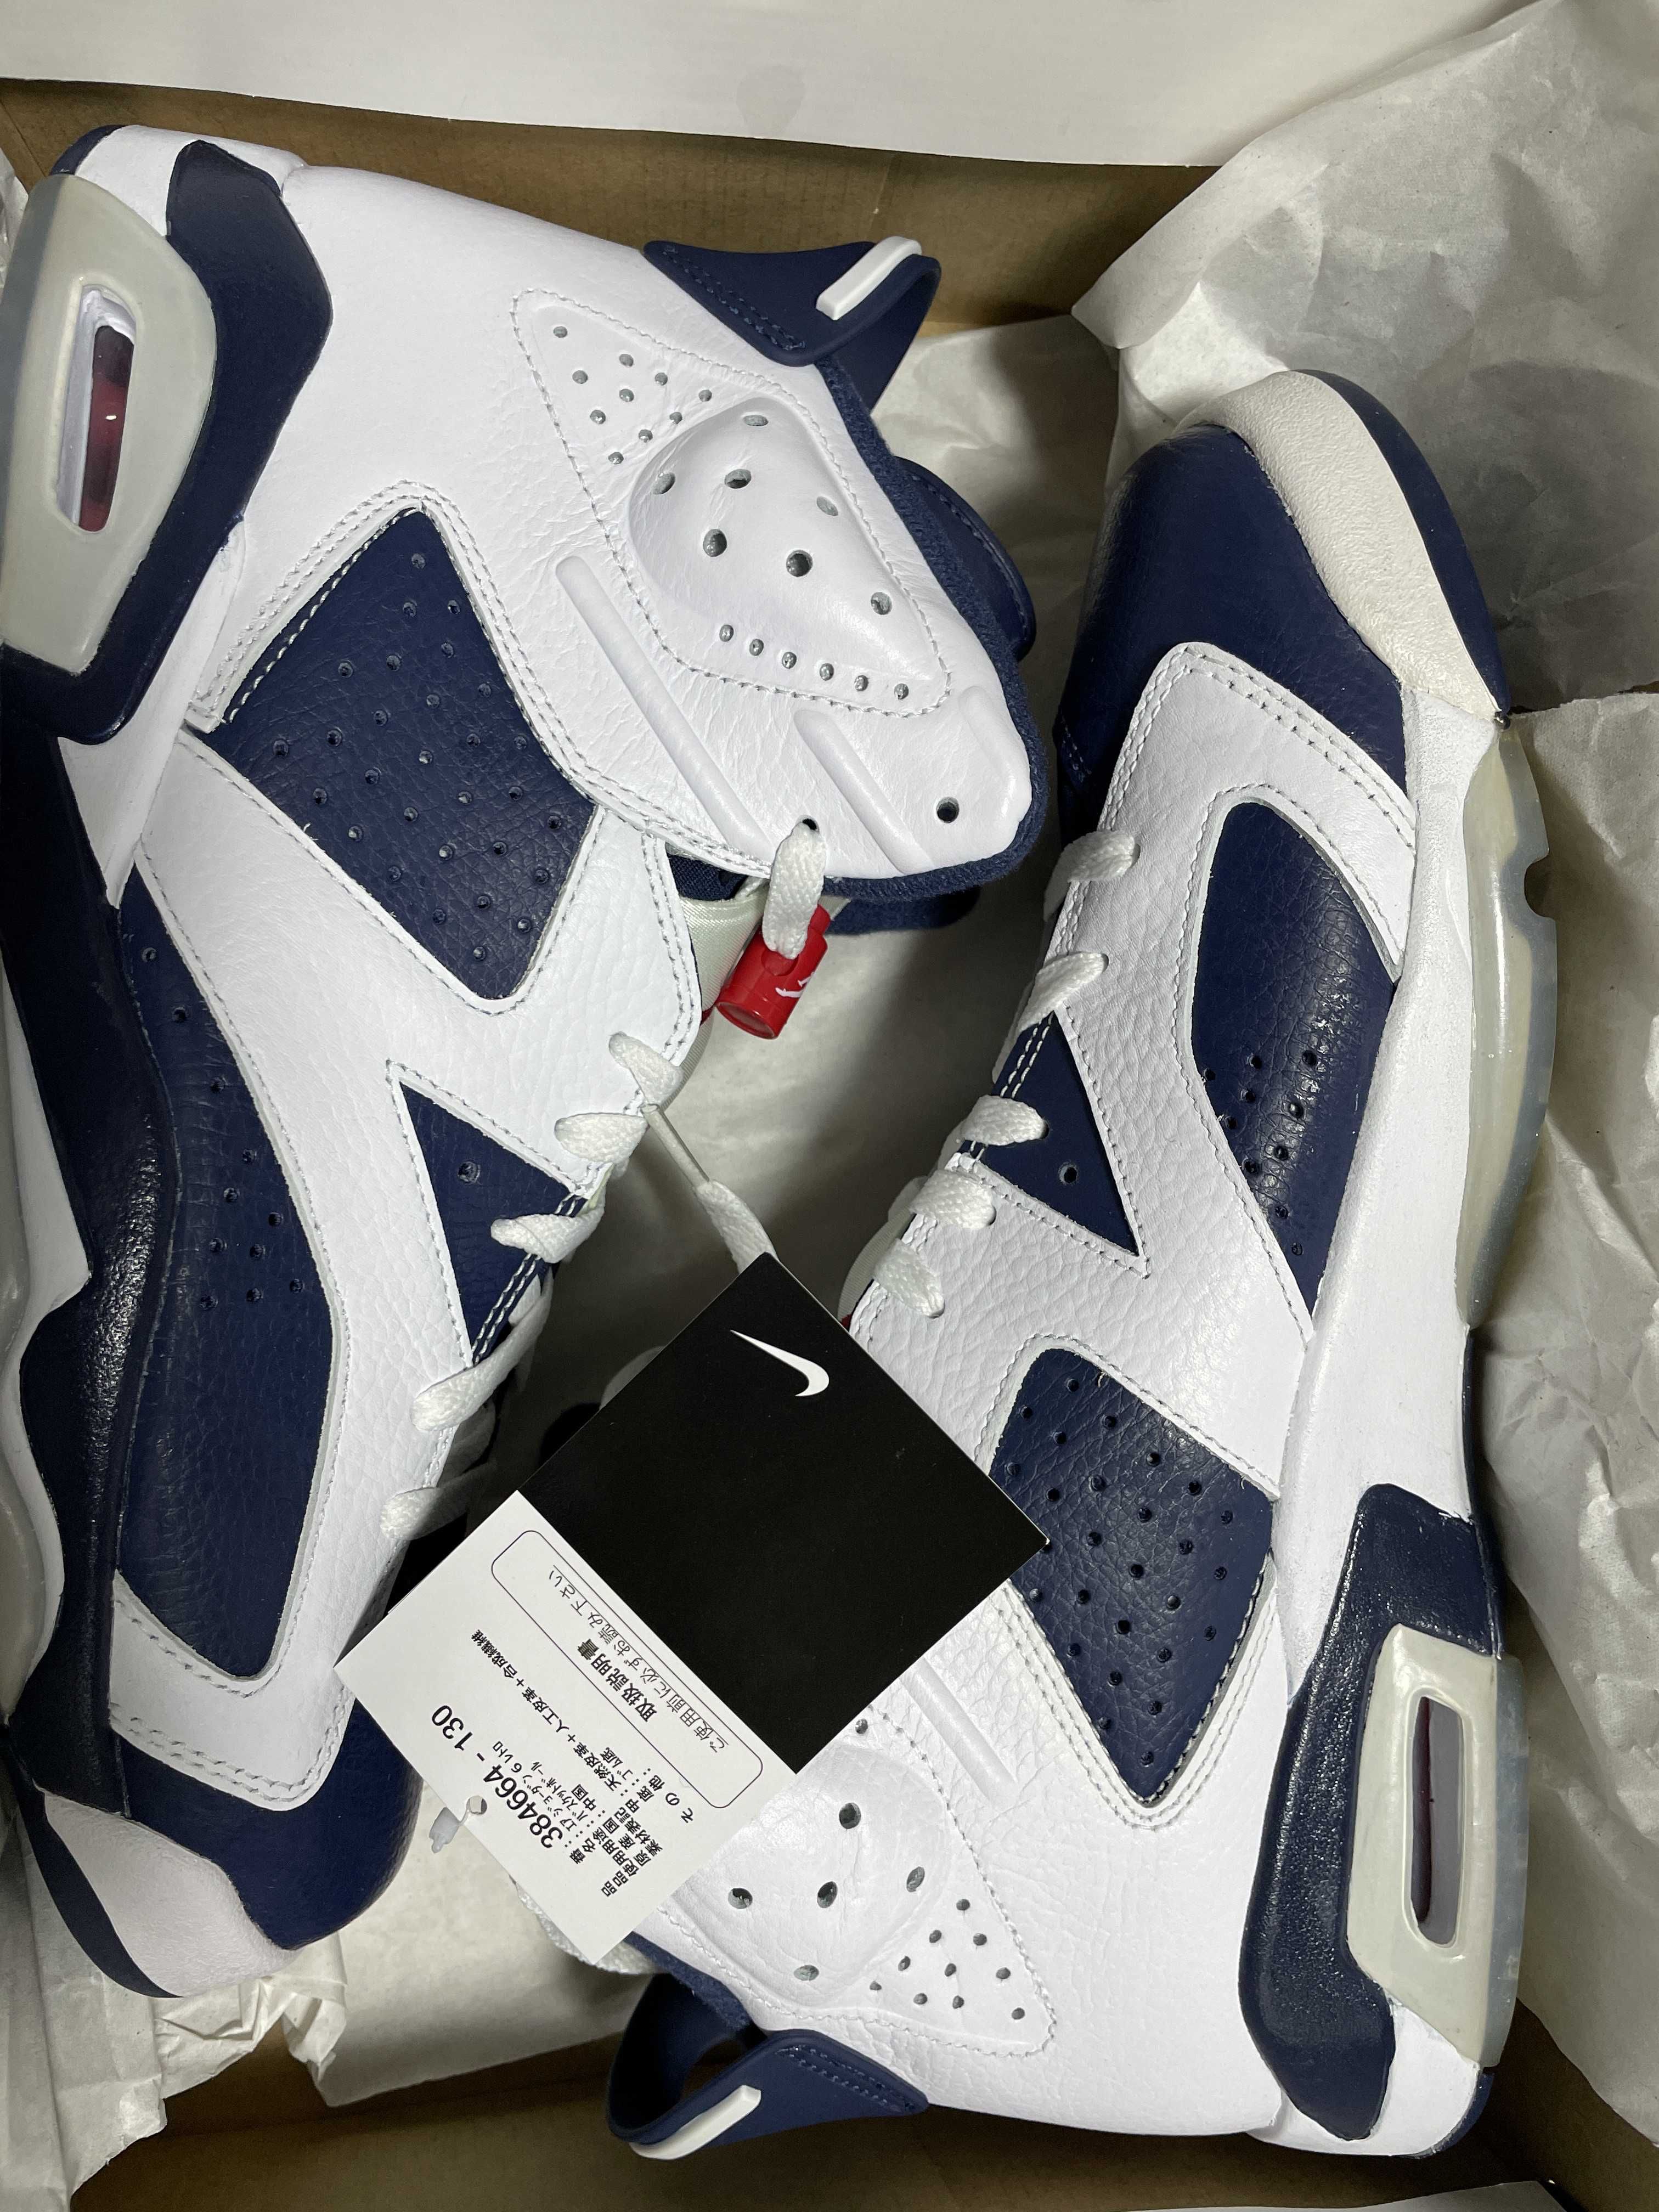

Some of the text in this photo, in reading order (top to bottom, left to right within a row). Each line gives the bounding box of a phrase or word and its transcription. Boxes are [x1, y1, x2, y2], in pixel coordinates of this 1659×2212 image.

[577, 1639, 657, 1722] 取扱説明書
[431, 1705, 473, 1751] 130
[483, 1764, 563, 1848] 384664
[613, 1807, 663, 1857] 素材表記
